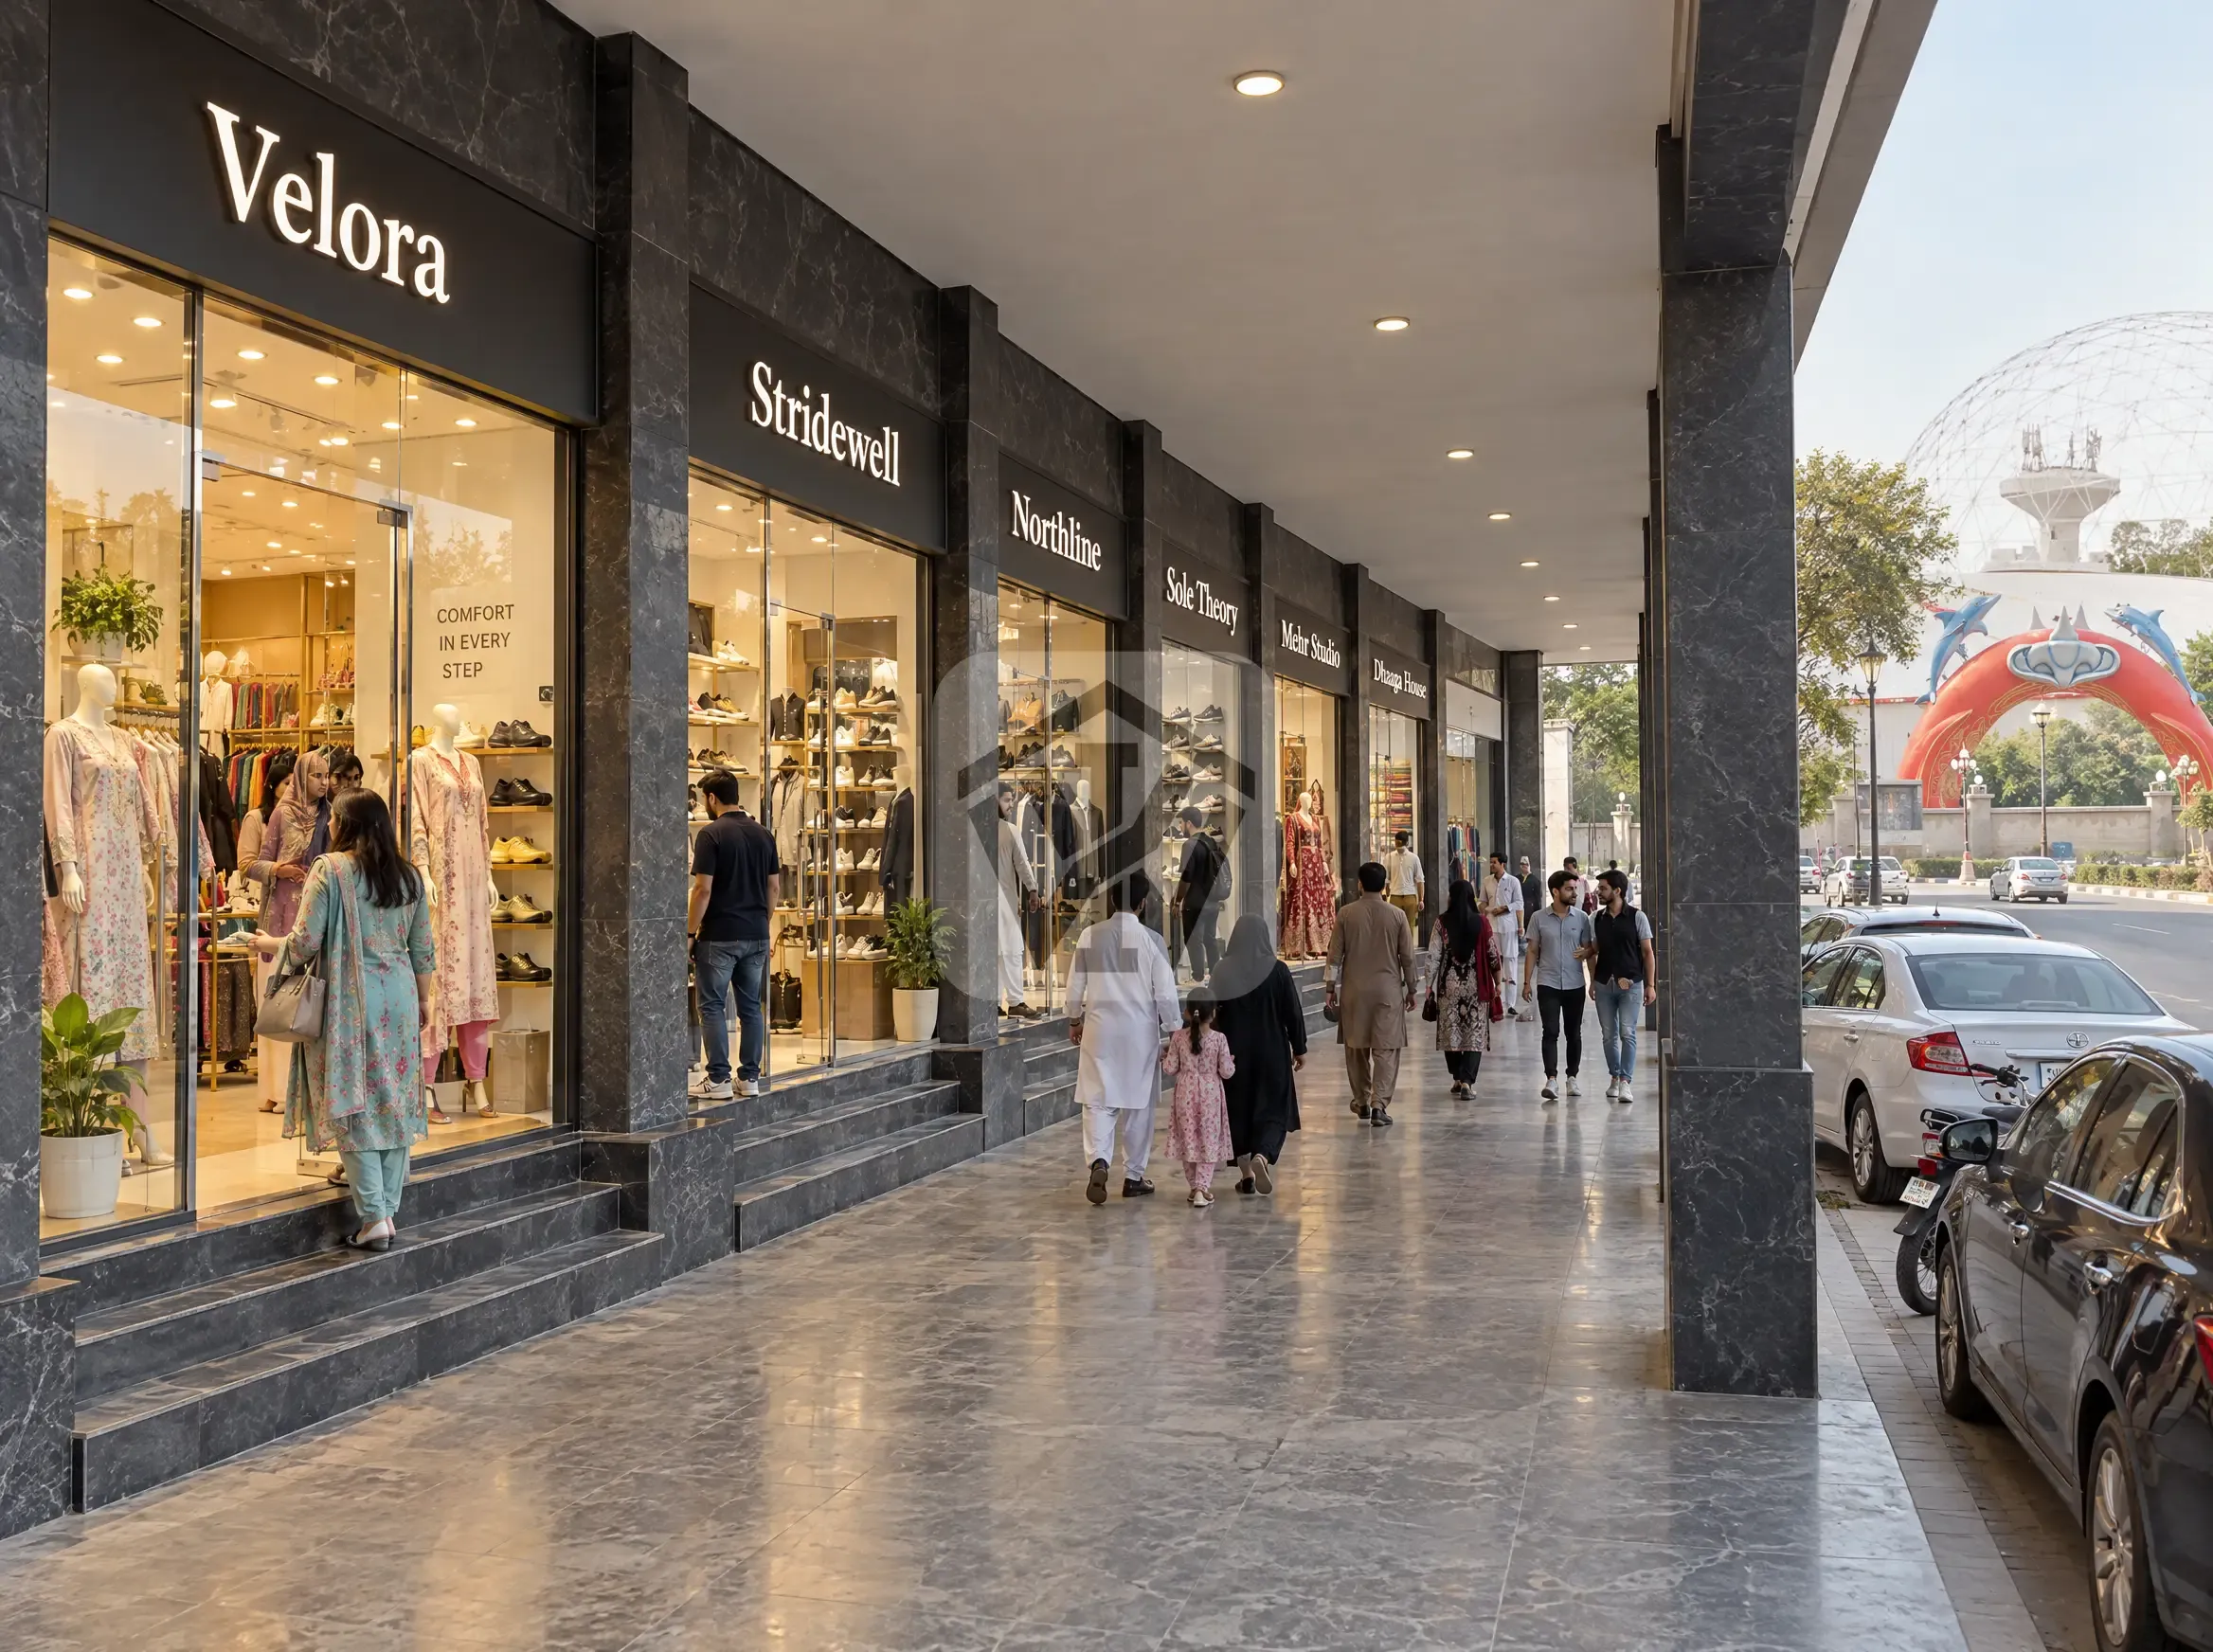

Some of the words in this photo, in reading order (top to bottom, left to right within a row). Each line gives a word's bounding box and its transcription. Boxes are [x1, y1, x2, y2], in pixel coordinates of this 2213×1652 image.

[207, 101, 450, 304] Velora
[751, 361, 901, 487] Stridewell
[1011, 490, 1103, 571] Northline
[437, 603, 514, 624] COMFORT
[1166, 566, 1194, 611] Sole
[1196, 580, 1239, 637] Theory
[440, 636, 455, 652] IN
[460, 632, 511, 650] EVERY
[1281, 619, 1309, 657] Mehr
[1310, 633, 1340, 669] Studio
[442, 661, 483, 679] STEP
[1373, 658, 1403, 694] Dhaaga
[1403, 670, 1427, 699] House
